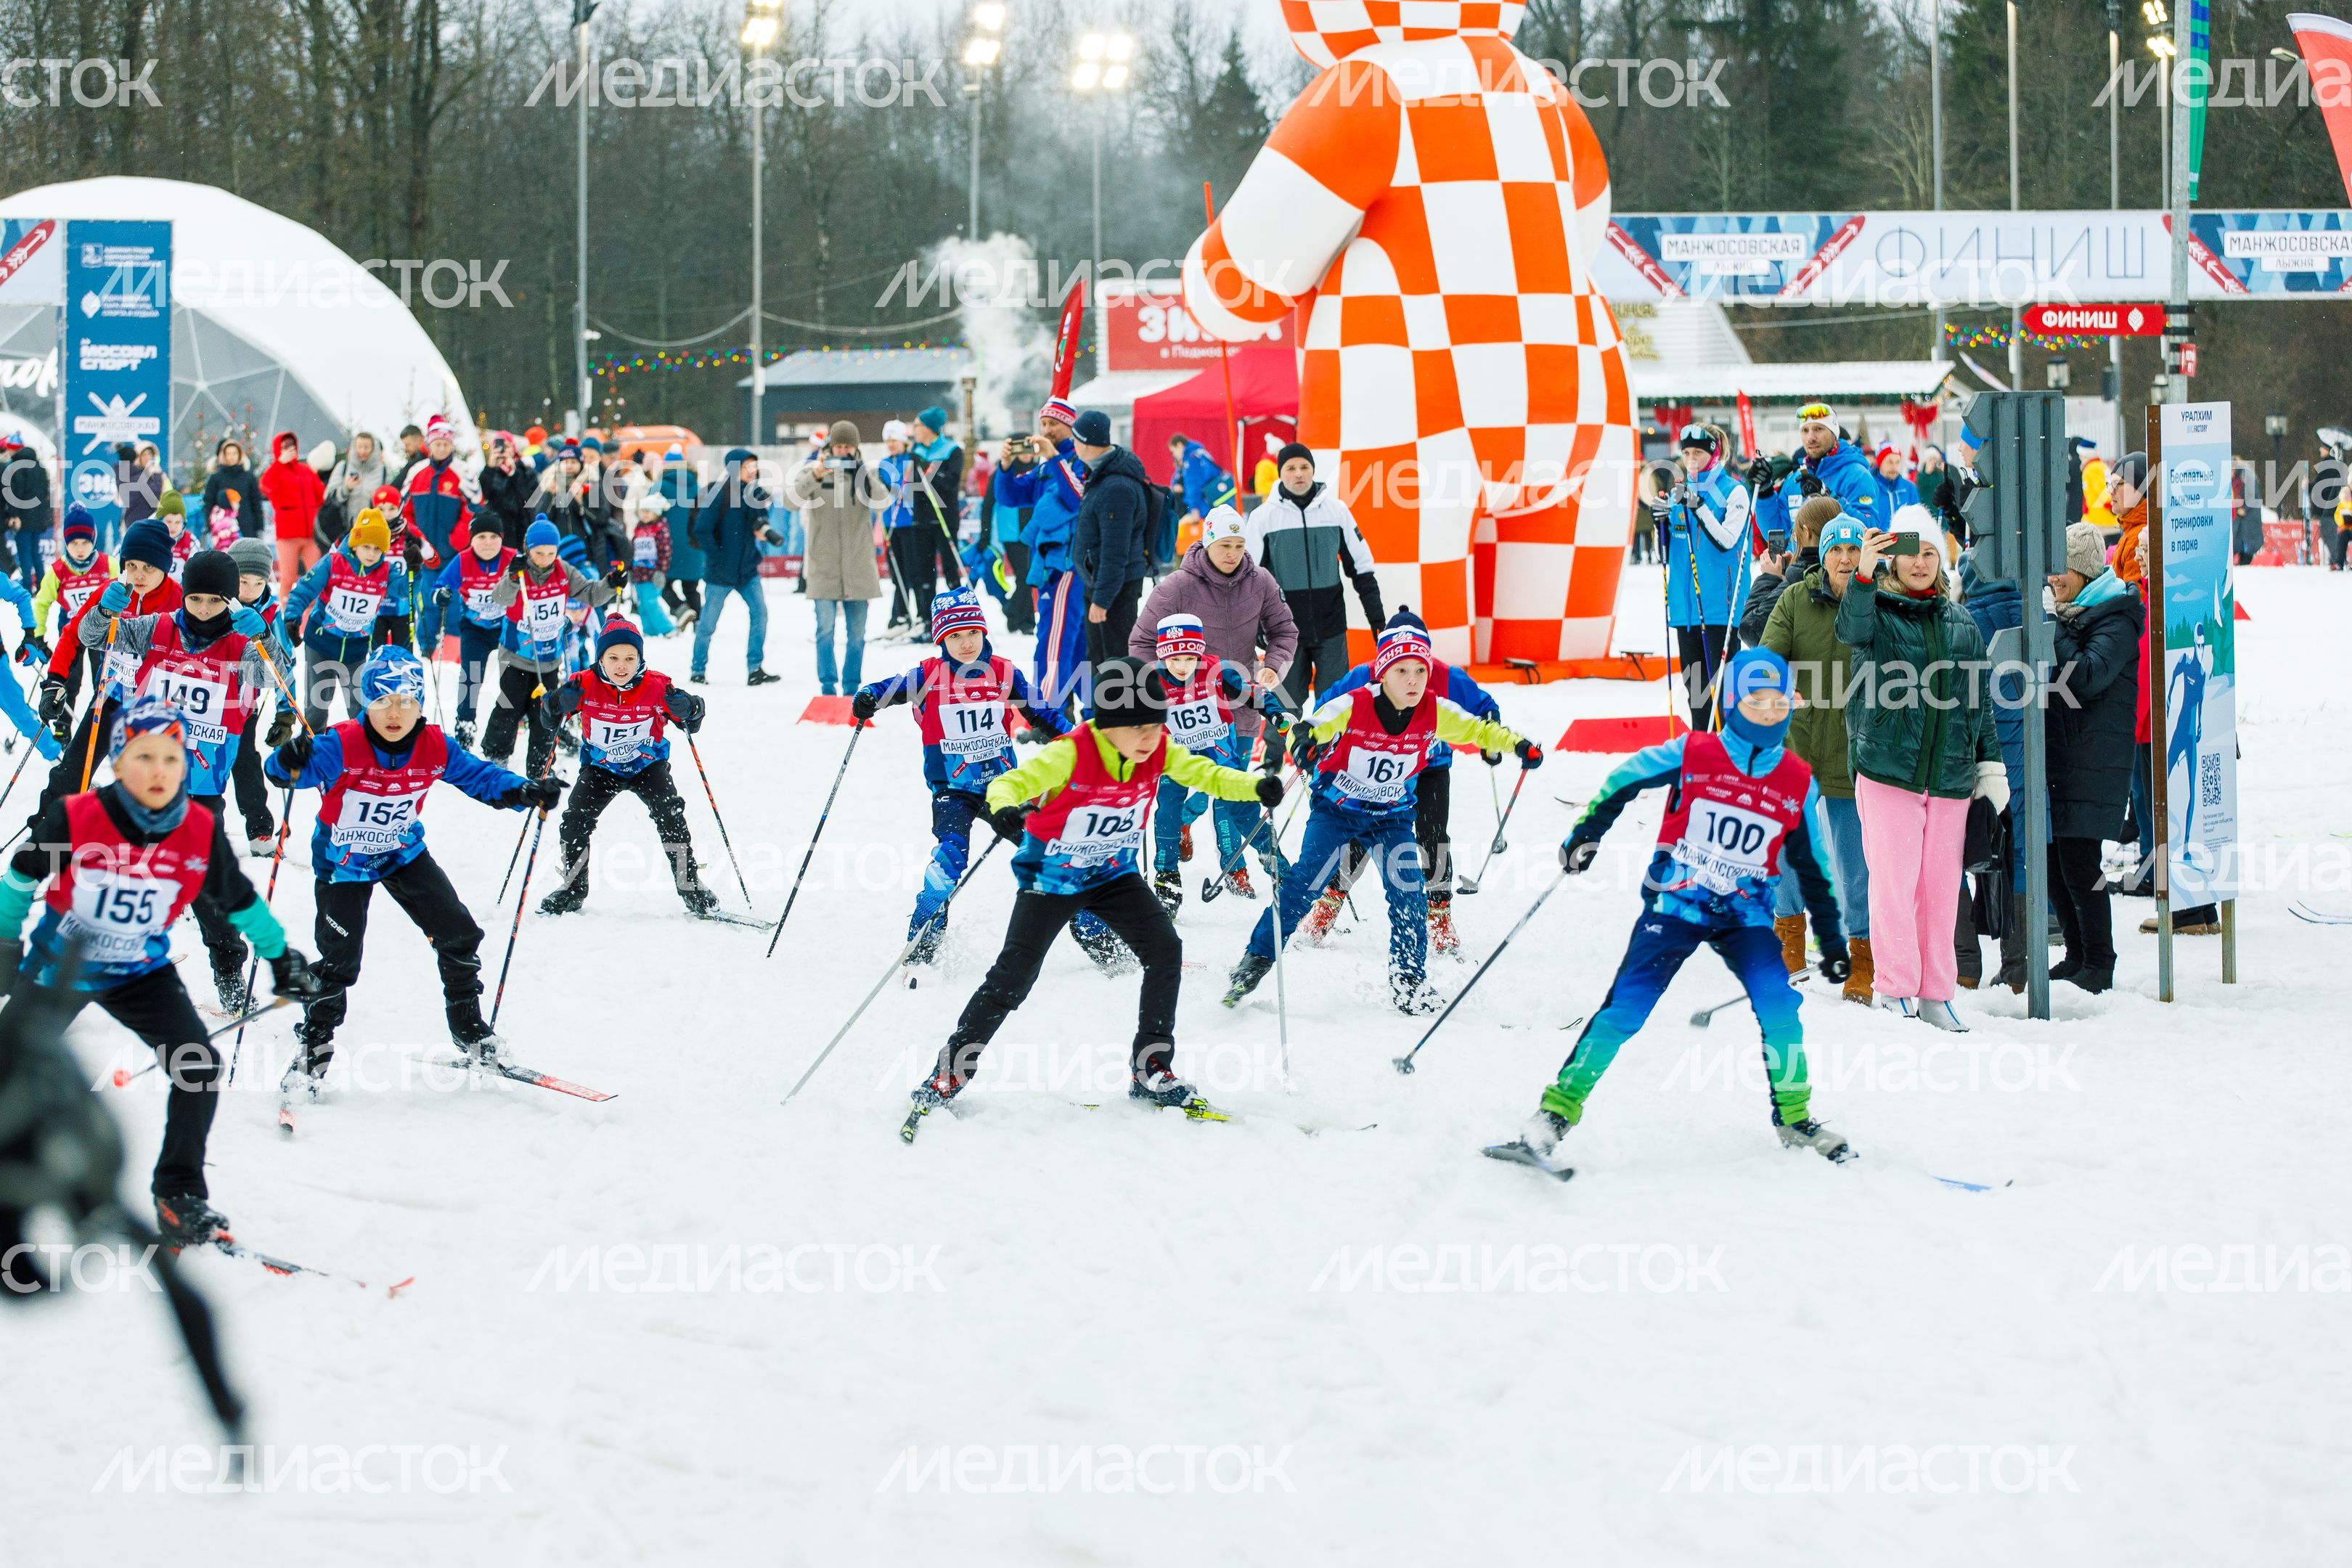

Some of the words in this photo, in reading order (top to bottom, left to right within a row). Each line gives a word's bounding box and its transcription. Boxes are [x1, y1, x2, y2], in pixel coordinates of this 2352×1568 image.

[1667, 239, 1800, 256] МАНЖОСОВСКАЯ
[1875, 224, 2144, 279] ФИНИШ
[2229, 236, 2352, 252] МАНЖОСОВСКА
[2276, 258, 2314, 268] ЛЫЖНЯ
[2041, 310, 2118, 330] ФИНИШ
[80, 359, 142, 371] СПОРТ
[2181, 409, 2213, 422] УРАЛХИМ
[2170, 469, 2213, 483] Бесплатные
[2171, 493, 2200, 507] лыжные
[2171, 515, 2213, 532] тренировки
[2171, 541, 2176, 552] в
[2177, 539, 2198, 554] парке
[71, 592, 93, 607] 15
[342, 595, 368, 613] 112
[534, 601, 560, 621] 154
[160, 679, 210, 714] 149
[956, 708, 995, 733] 114
[1171, 704, 1212, 730] 163
[359, 799, 413, 825] 152
[1085, 809, 1135, 837] 108
[1706, 812, 1765, 855] 100
[94, 884, 157, 923] 155
[324, 913, 350, 938] VITZHEN
